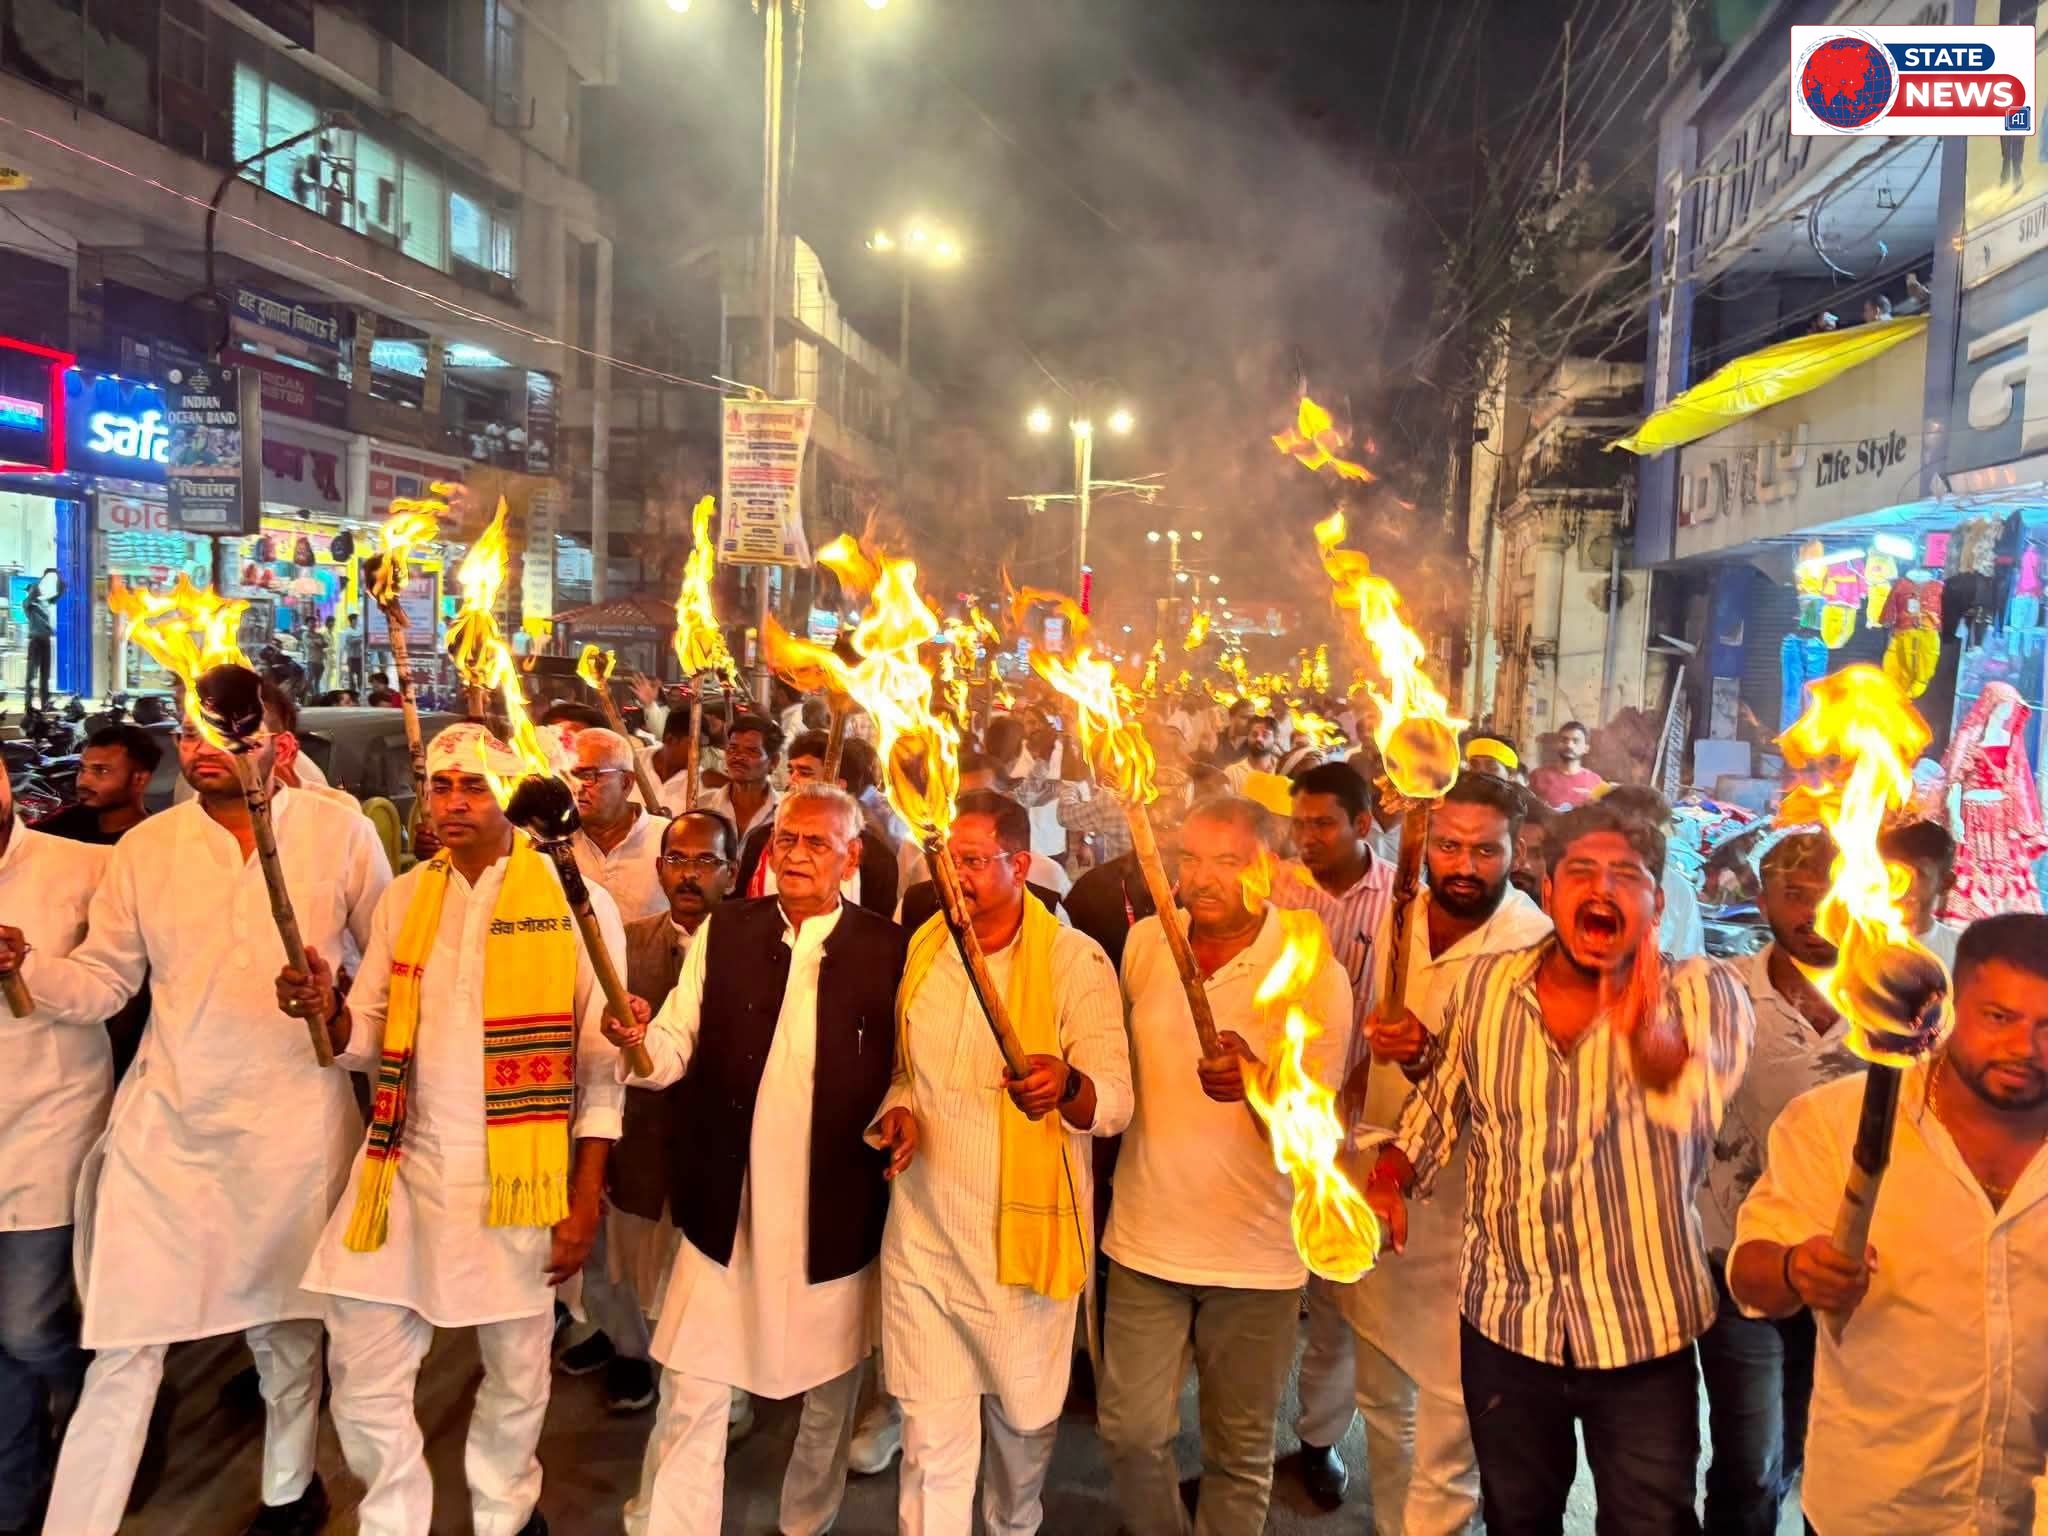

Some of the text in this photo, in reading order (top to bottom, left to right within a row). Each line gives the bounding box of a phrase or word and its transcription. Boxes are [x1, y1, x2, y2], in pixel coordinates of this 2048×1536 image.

[238, 289, 338, 343] यह दुकान बिकाऊ है
[182, 395, 220, 409] INDIAN
[168, 411, 236, 425] OCEAN BAND
[1816, 448, 1850, 488] Life
[1856, 429, 1906, 478] Style
[490, 918, 515, 935] सेवा
[517, 917, 558, 932] जोहार
